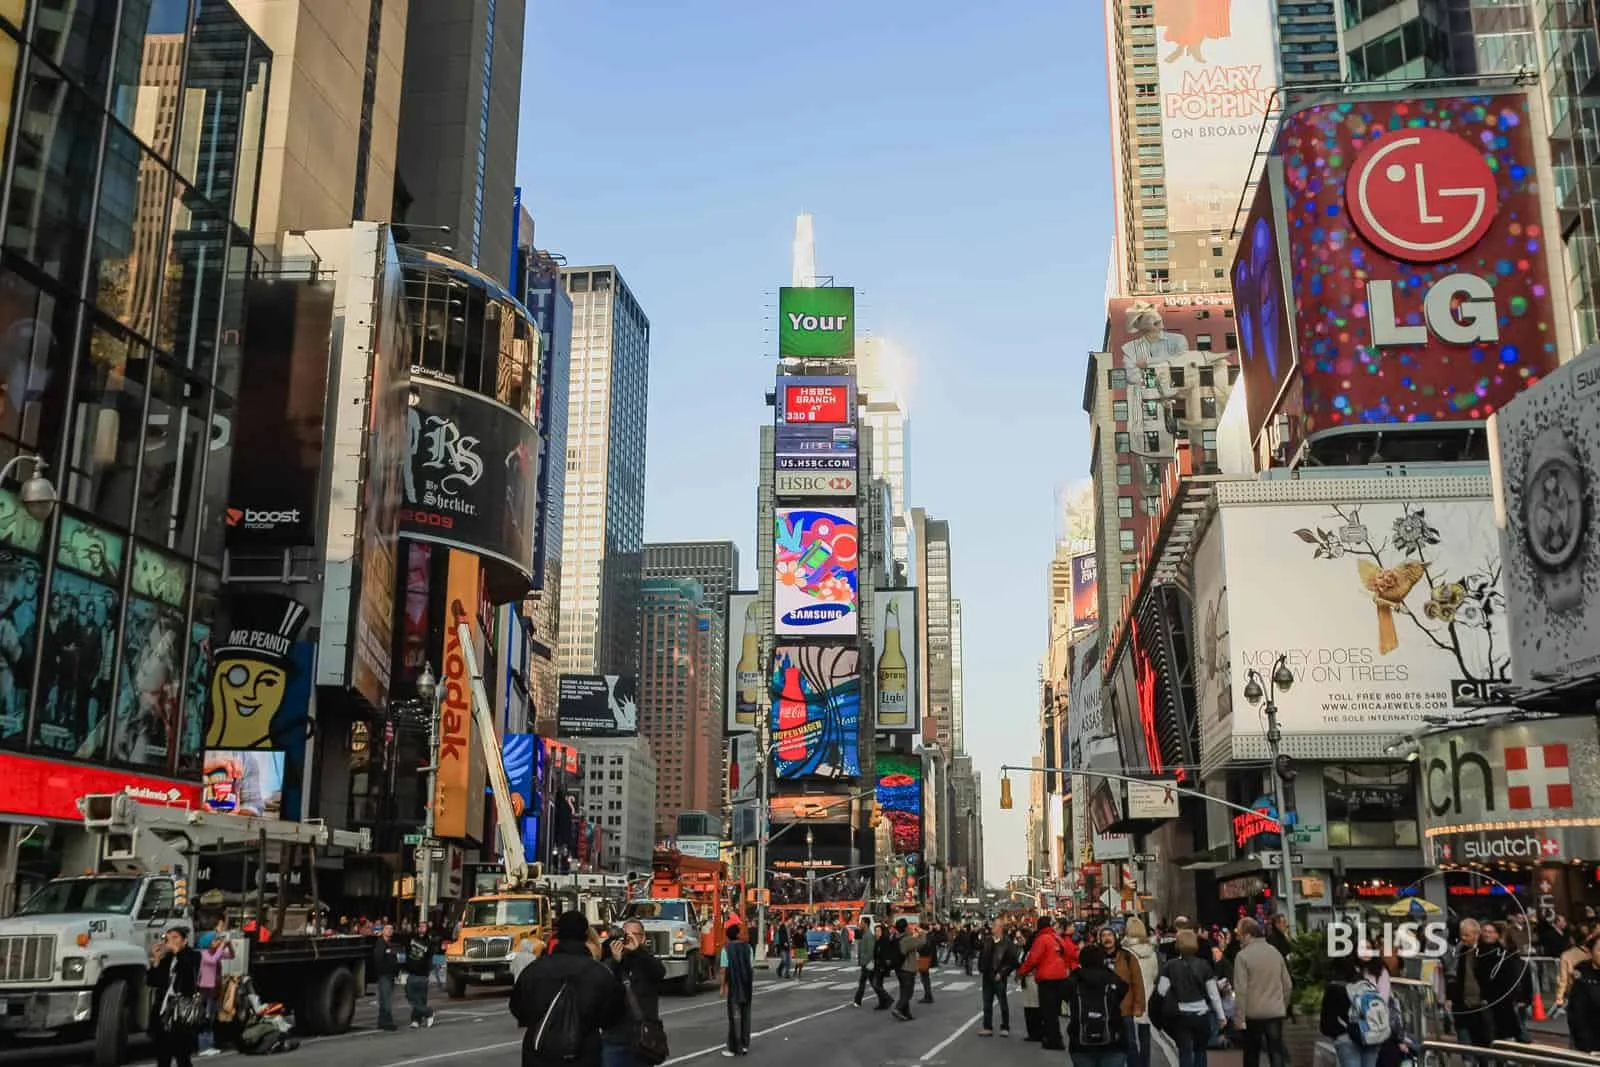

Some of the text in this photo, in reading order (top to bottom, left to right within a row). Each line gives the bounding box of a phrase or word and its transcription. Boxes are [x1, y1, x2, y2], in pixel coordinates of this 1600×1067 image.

[1182, 64, 1261, 95] MARY
[1172, 127, 1193, 140] ON
[1367, 273, 1499, 348] LG
[788, 313, 848, 331] Your
[800, 387, 832, 395] HSBC
[780, 477, 826, 489] HSBC
[245, 509, 300, 523] boost
[790, 609, 843, 620] SAMSUNG
[249, 631, 290, 655] PEANUT
[1242, 648, 1373, 665] MONEY DOES
[1312, 666, 1341, 682] ON
[1346, 664, 1409, 681] TREES
[1329, 693, 1352, 701] TOLL
[1464, 835, 1541, 858] swatch
